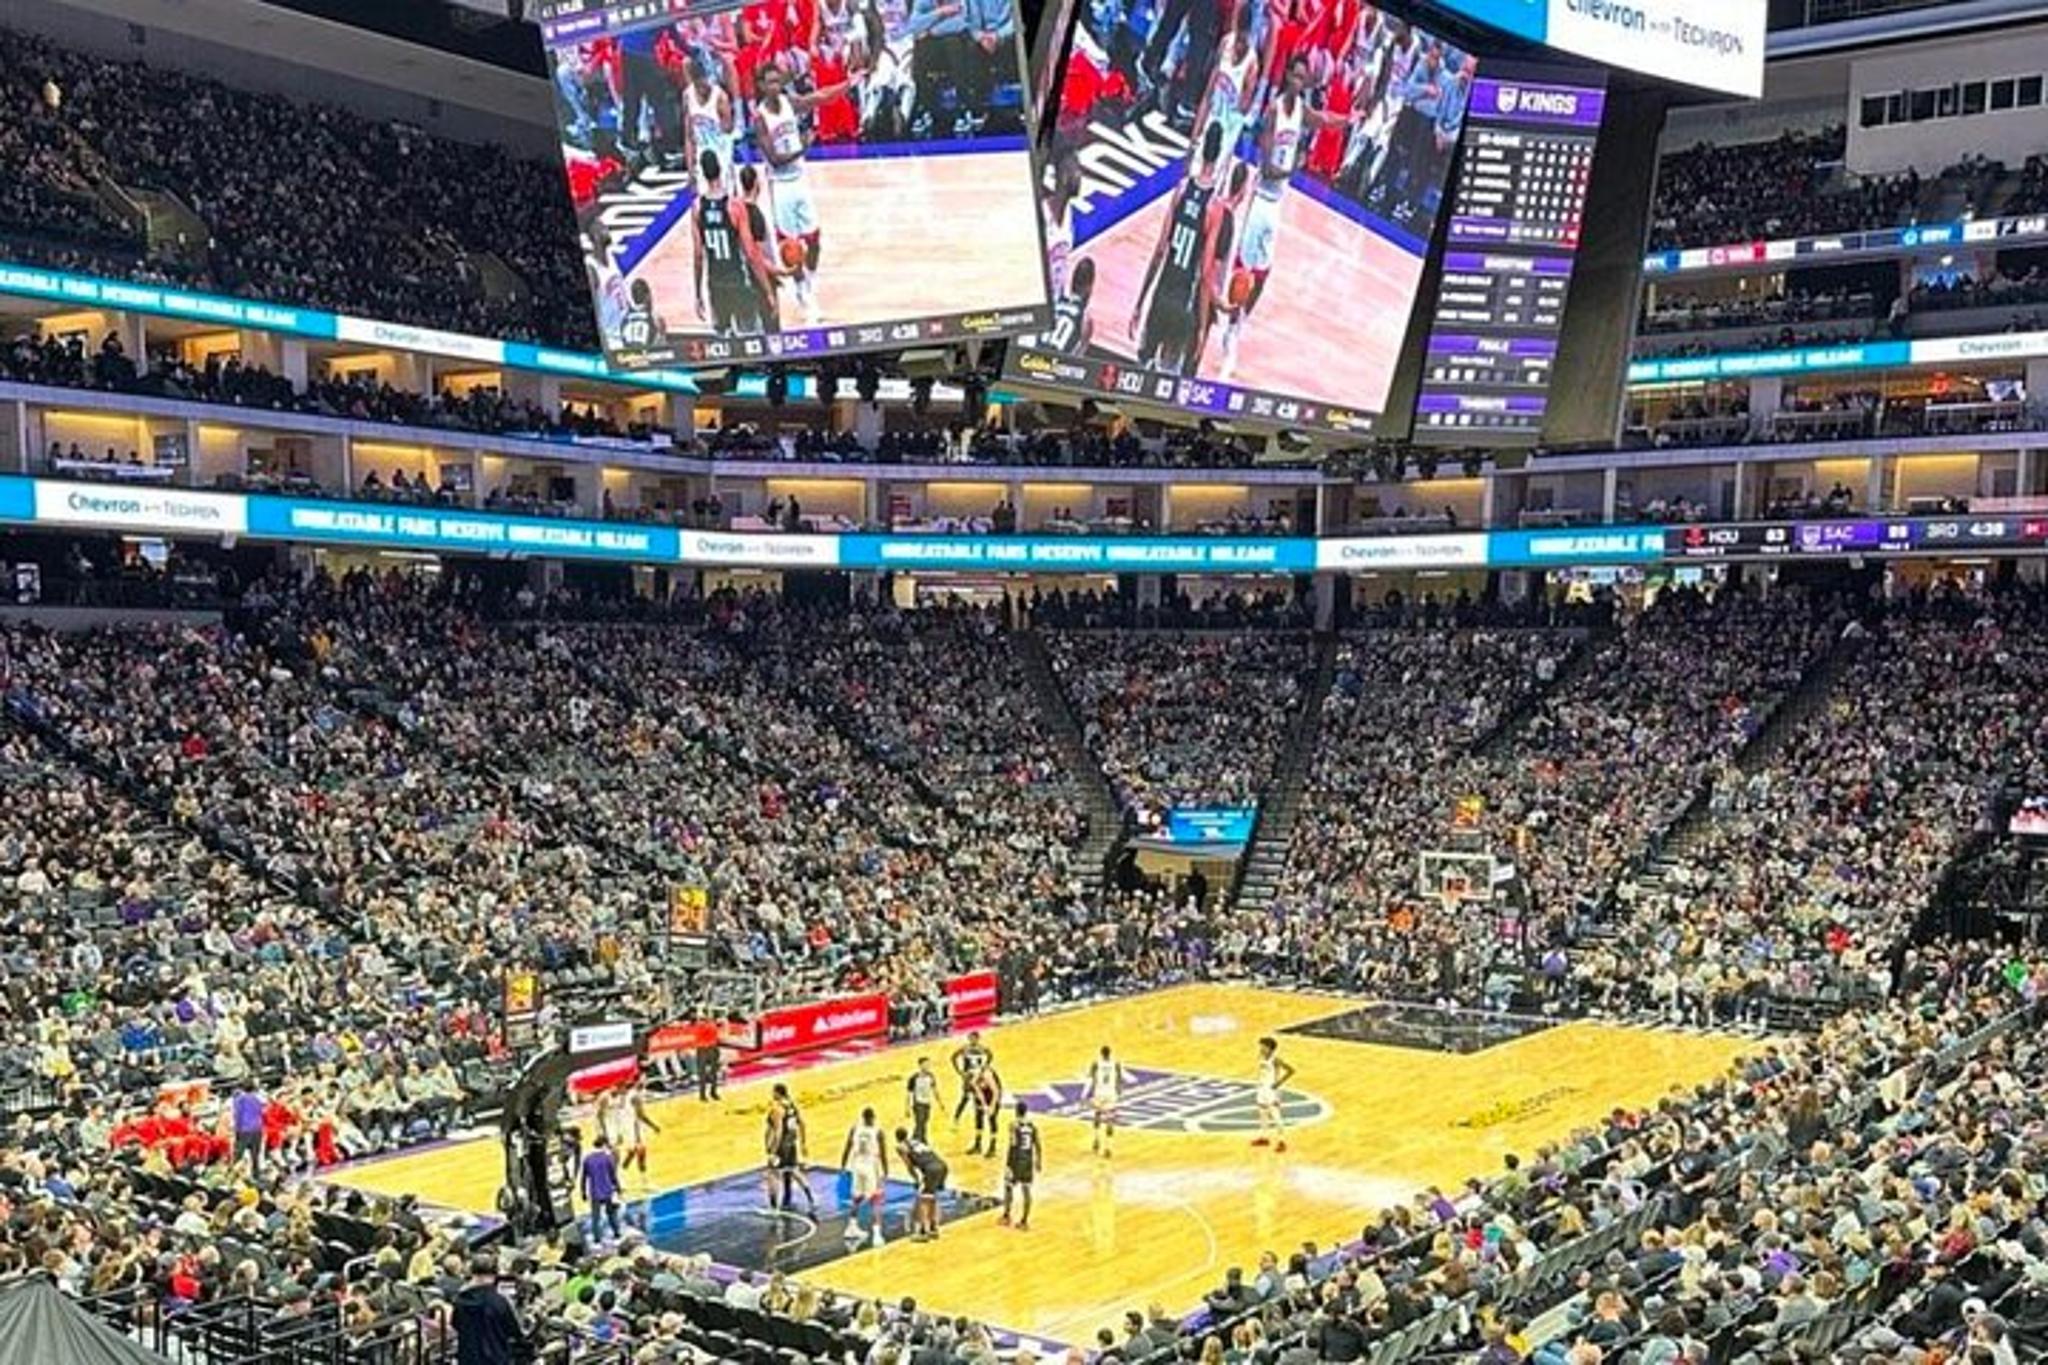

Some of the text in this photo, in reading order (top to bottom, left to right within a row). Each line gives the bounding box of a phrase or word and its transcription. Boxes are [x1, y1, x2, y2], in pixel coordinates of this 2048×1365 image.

[1518, 90, 1578, 114] KINGS
[704, 229, 730, 260] 41
[1171, 222, 1197, 270] 41
[67, 491, 141, 514] Chevron
[1708, 530, 1739, 544] HOU
[1823, 525, 1855, 540] SAC
